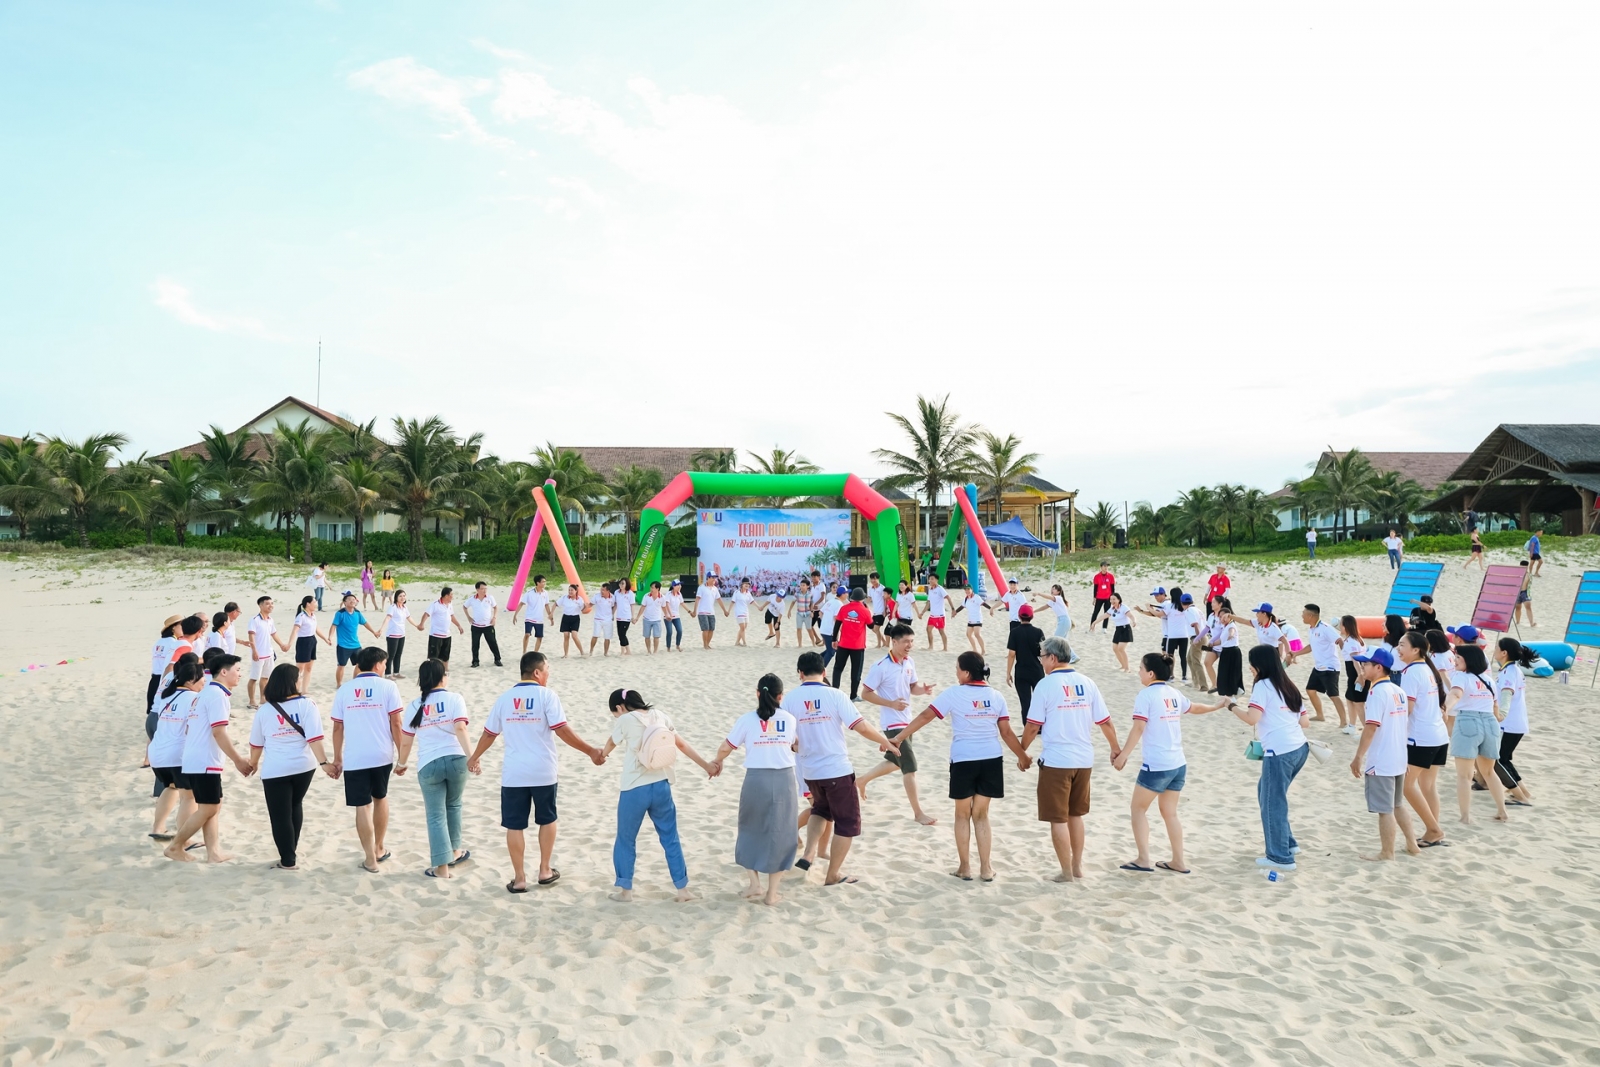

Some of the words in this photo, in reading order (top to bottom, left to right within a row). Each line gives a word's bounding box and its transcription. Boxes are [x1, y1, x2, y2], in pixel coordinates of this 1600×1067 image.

[738, 523, 765, 537] TEAM
[768, 523, 813, 537] BUILDING
[810, 539, 828, 548] 2024
[634, 559, 645, 579] TEAM
[641, 527, 659, 559] BUILDING
[1063, 684, 1084, 697] VKU
[513, 698, 534, 710] VKU
[804, 699, 821, 711] VKU
[972, 700, 991, 709] VKU
[760, 720, 785, 733] VKU
